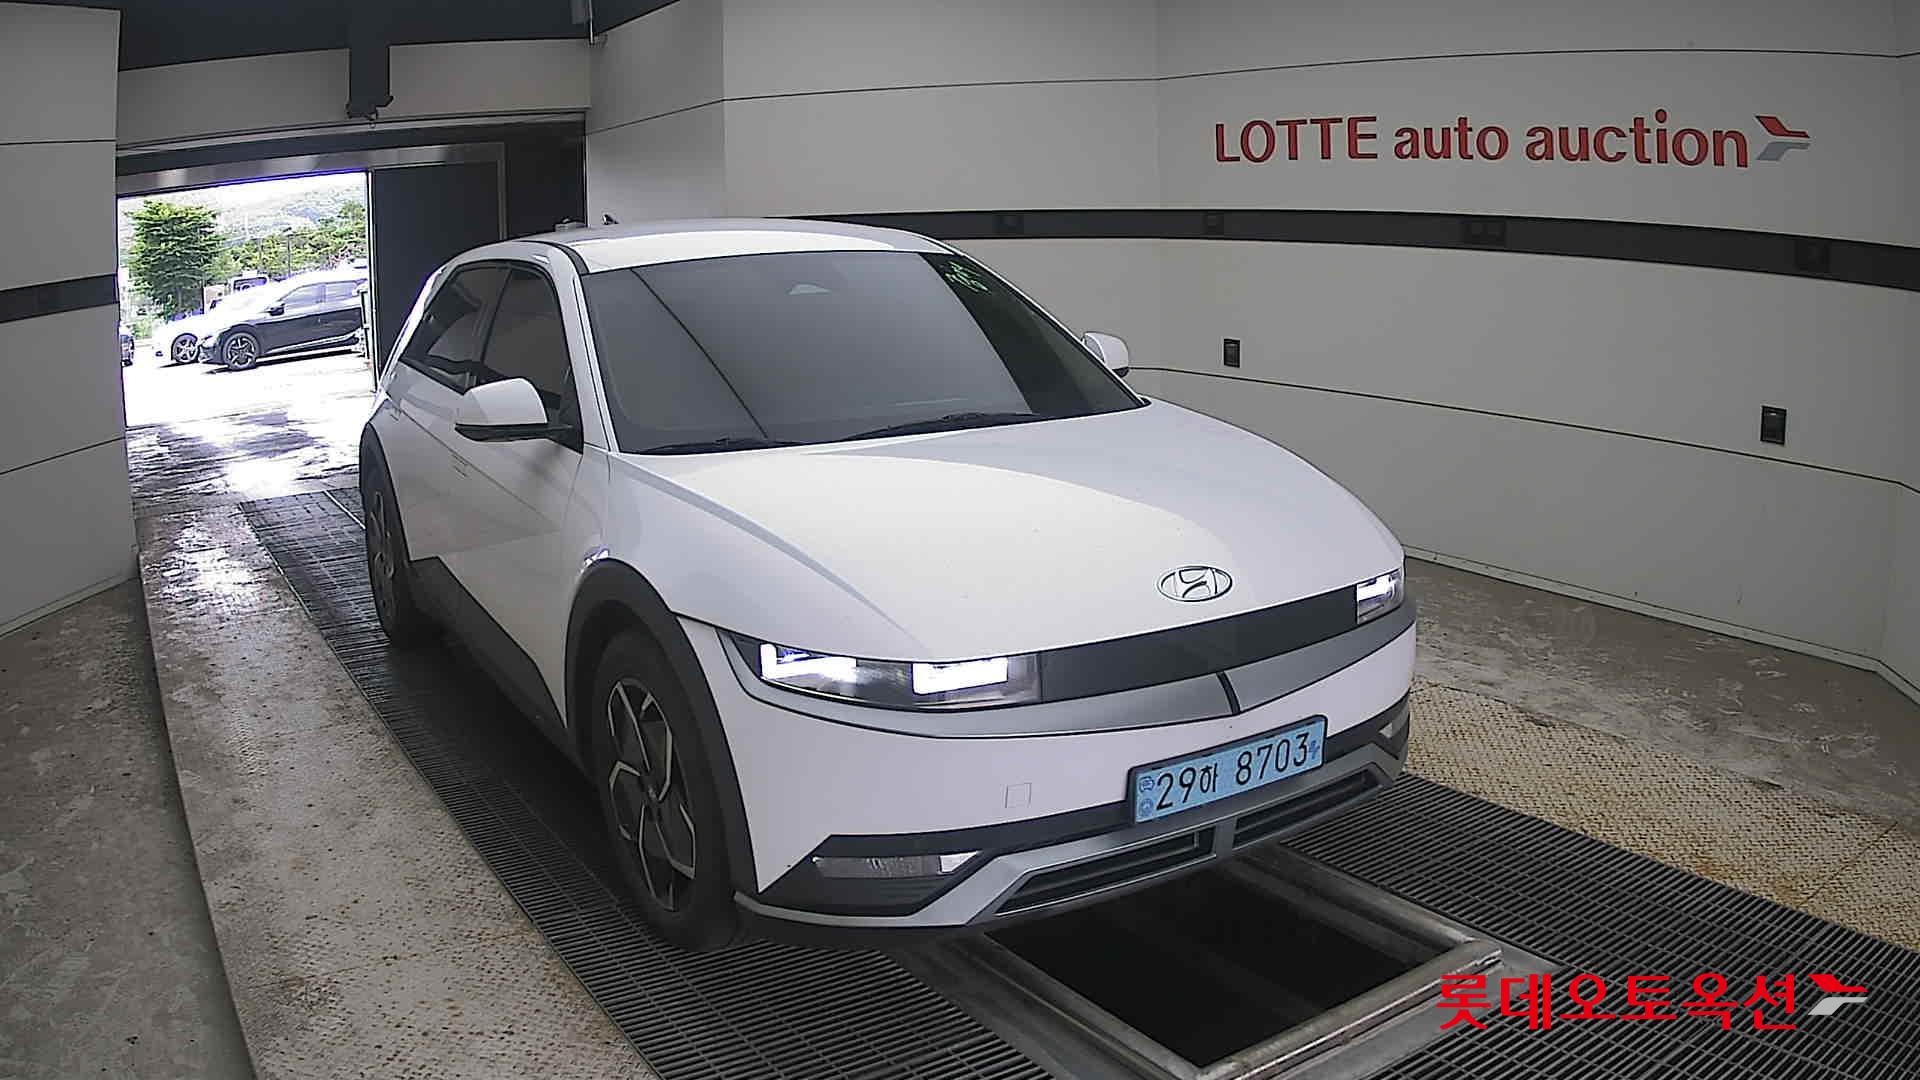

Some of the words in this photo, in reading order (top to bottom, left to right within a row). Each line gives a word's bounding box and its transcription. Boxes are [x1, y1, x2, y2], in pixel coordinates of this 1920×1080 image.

[1216, 116, 1377, 162] LOTTE
[1394, 117, 1509, 161] auto
[1526, 109, 1748, 168] auction
[1156, 763, 1218, 810] 29하
[1236, 732, 1310, 785] 8703
